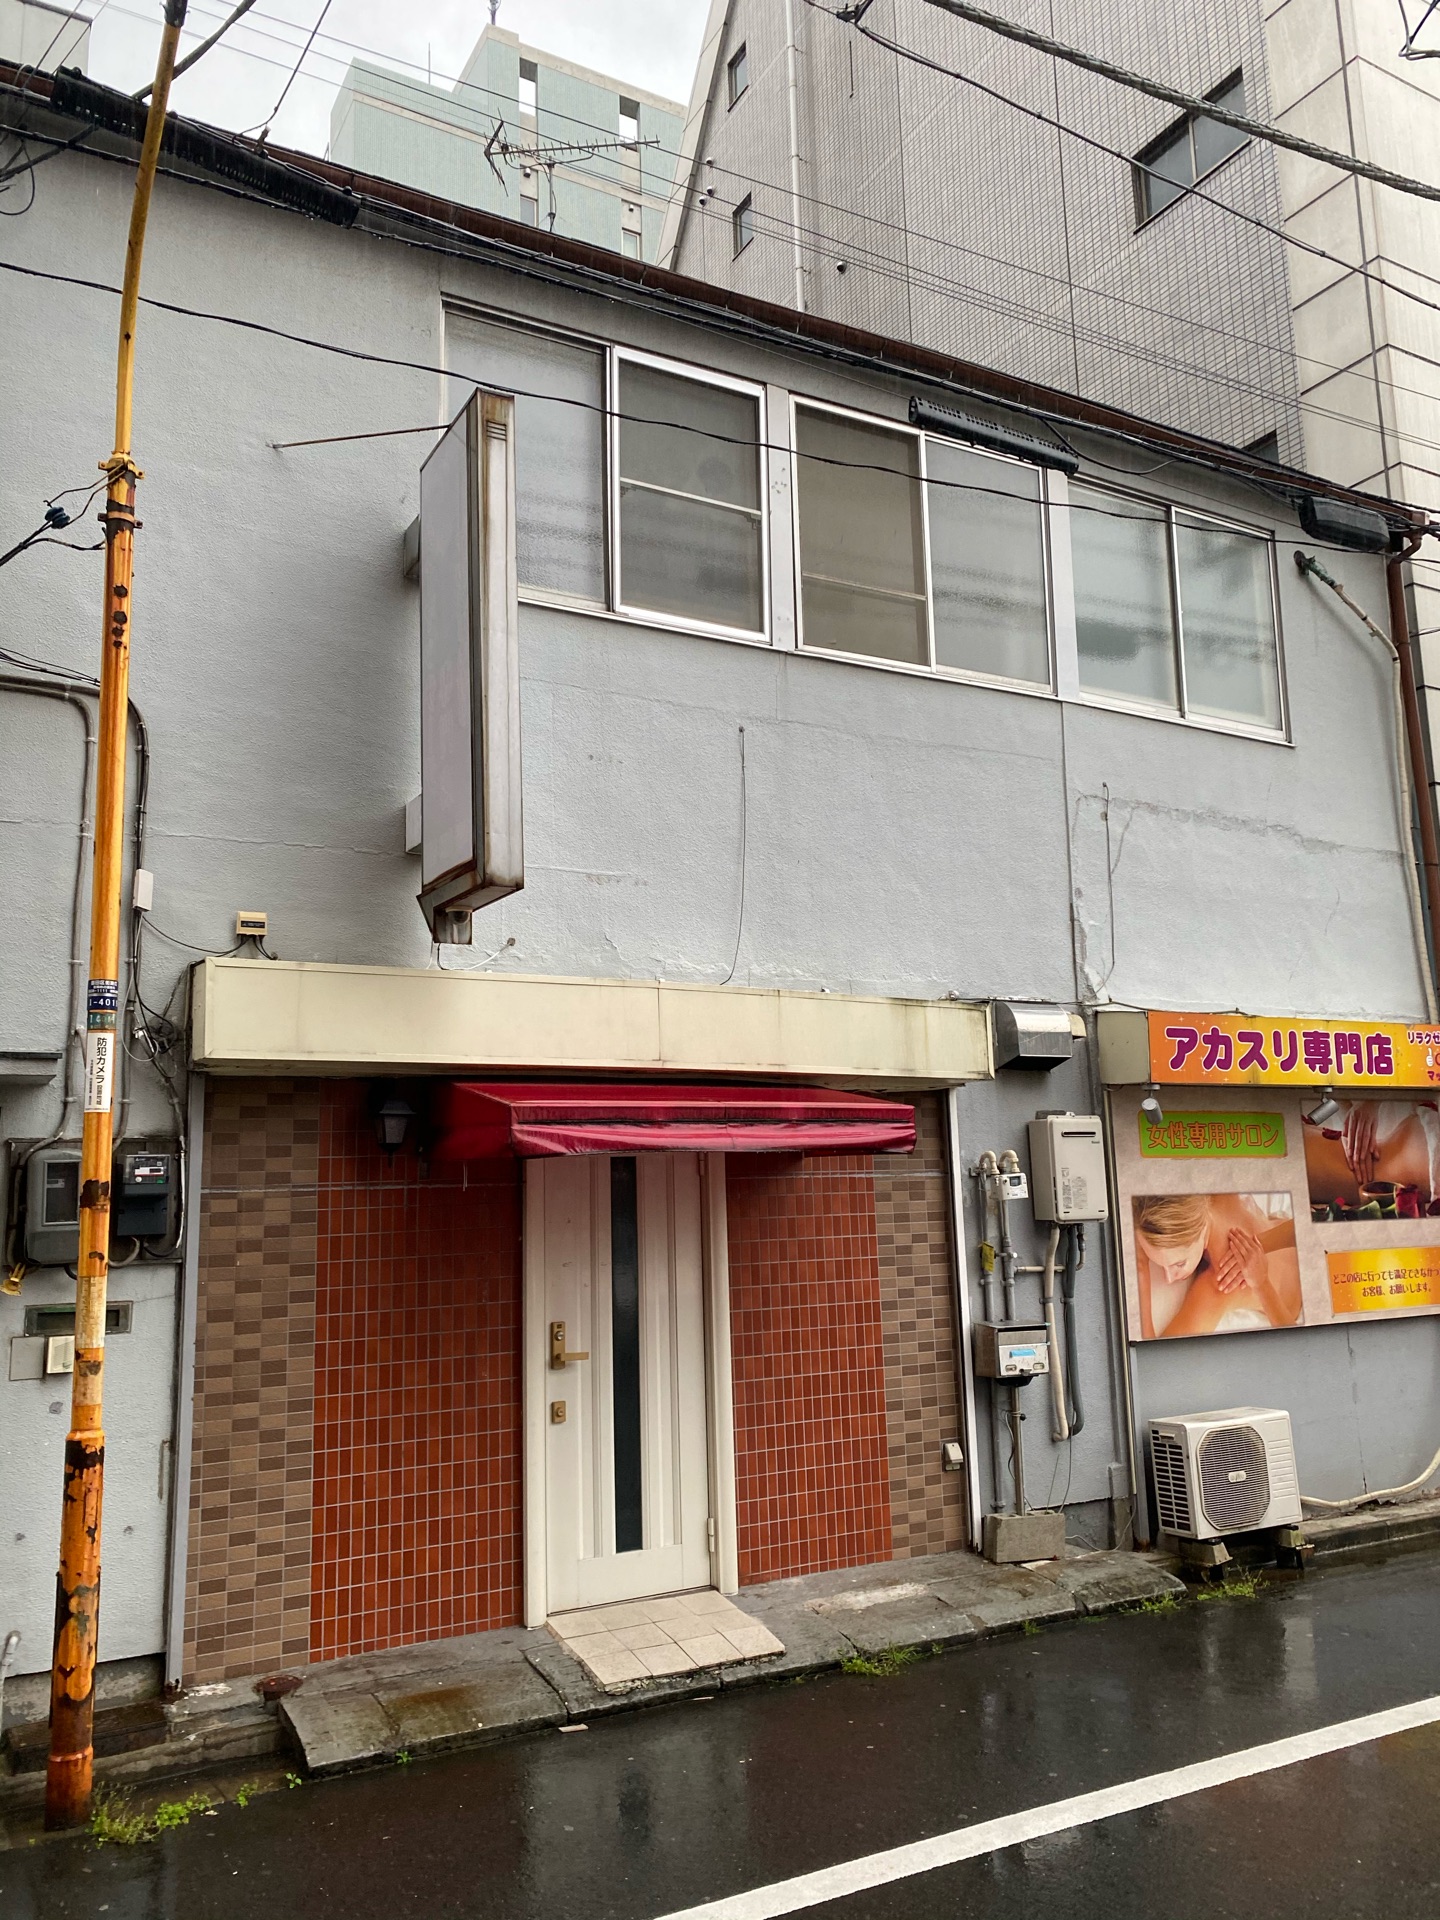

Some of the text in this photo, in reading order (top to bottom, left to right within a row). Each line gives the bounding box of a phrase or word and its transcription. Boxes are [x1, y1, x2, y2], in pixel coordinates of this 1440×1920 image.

[1165, 1026, 1394, 1076] アカスリ専門店
[1146, 1120, 1279, 1149] 女性専用サロン
